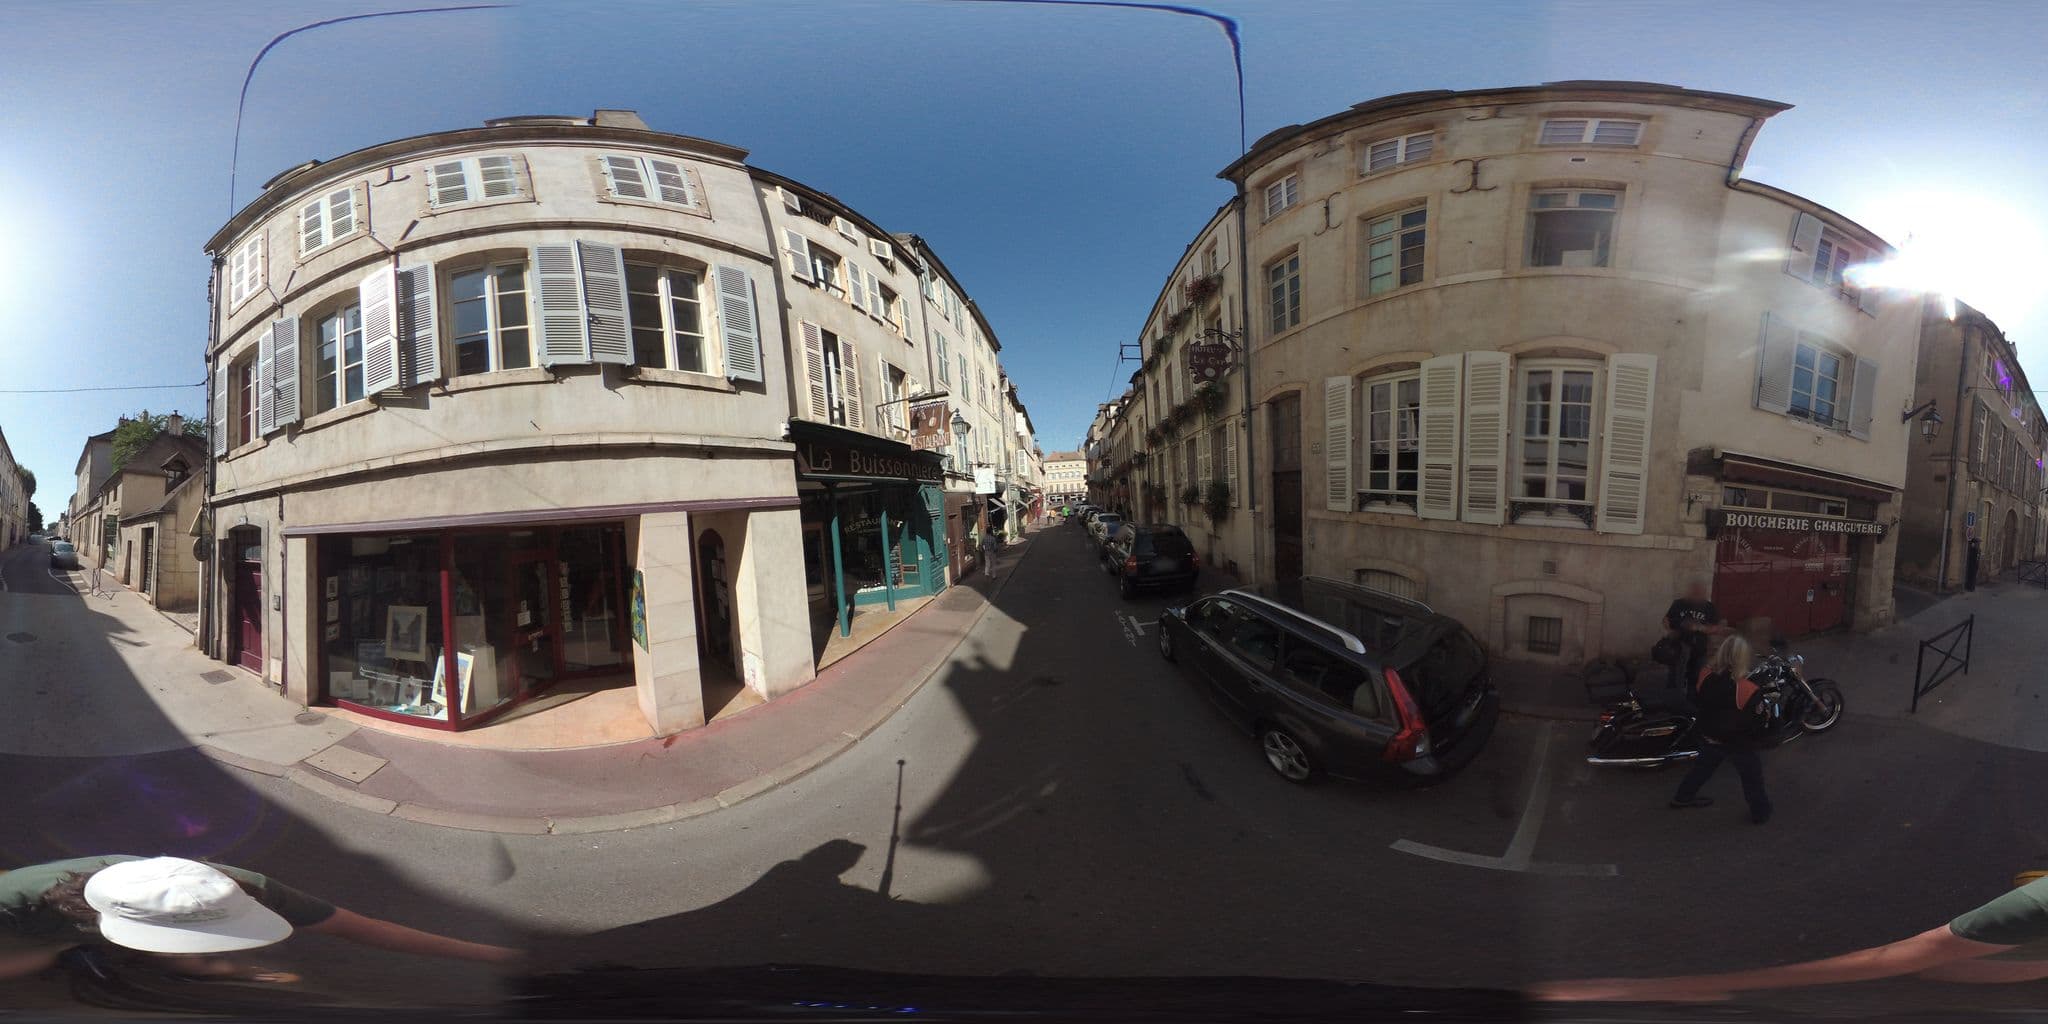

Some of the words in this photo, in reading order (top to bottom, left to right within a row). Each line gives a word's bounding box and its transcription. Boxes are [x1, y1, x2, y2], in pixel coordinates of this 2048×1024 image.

[911, 432, 951, 451] RESTAURANT
[809, 443, 833, 472] La
[844, 517, 904, 535] RESTAUNT
[1725, 513, 1810, 531] BOUCHERIE
[1814, 519, 1883, 535] CHARCUTERIE
